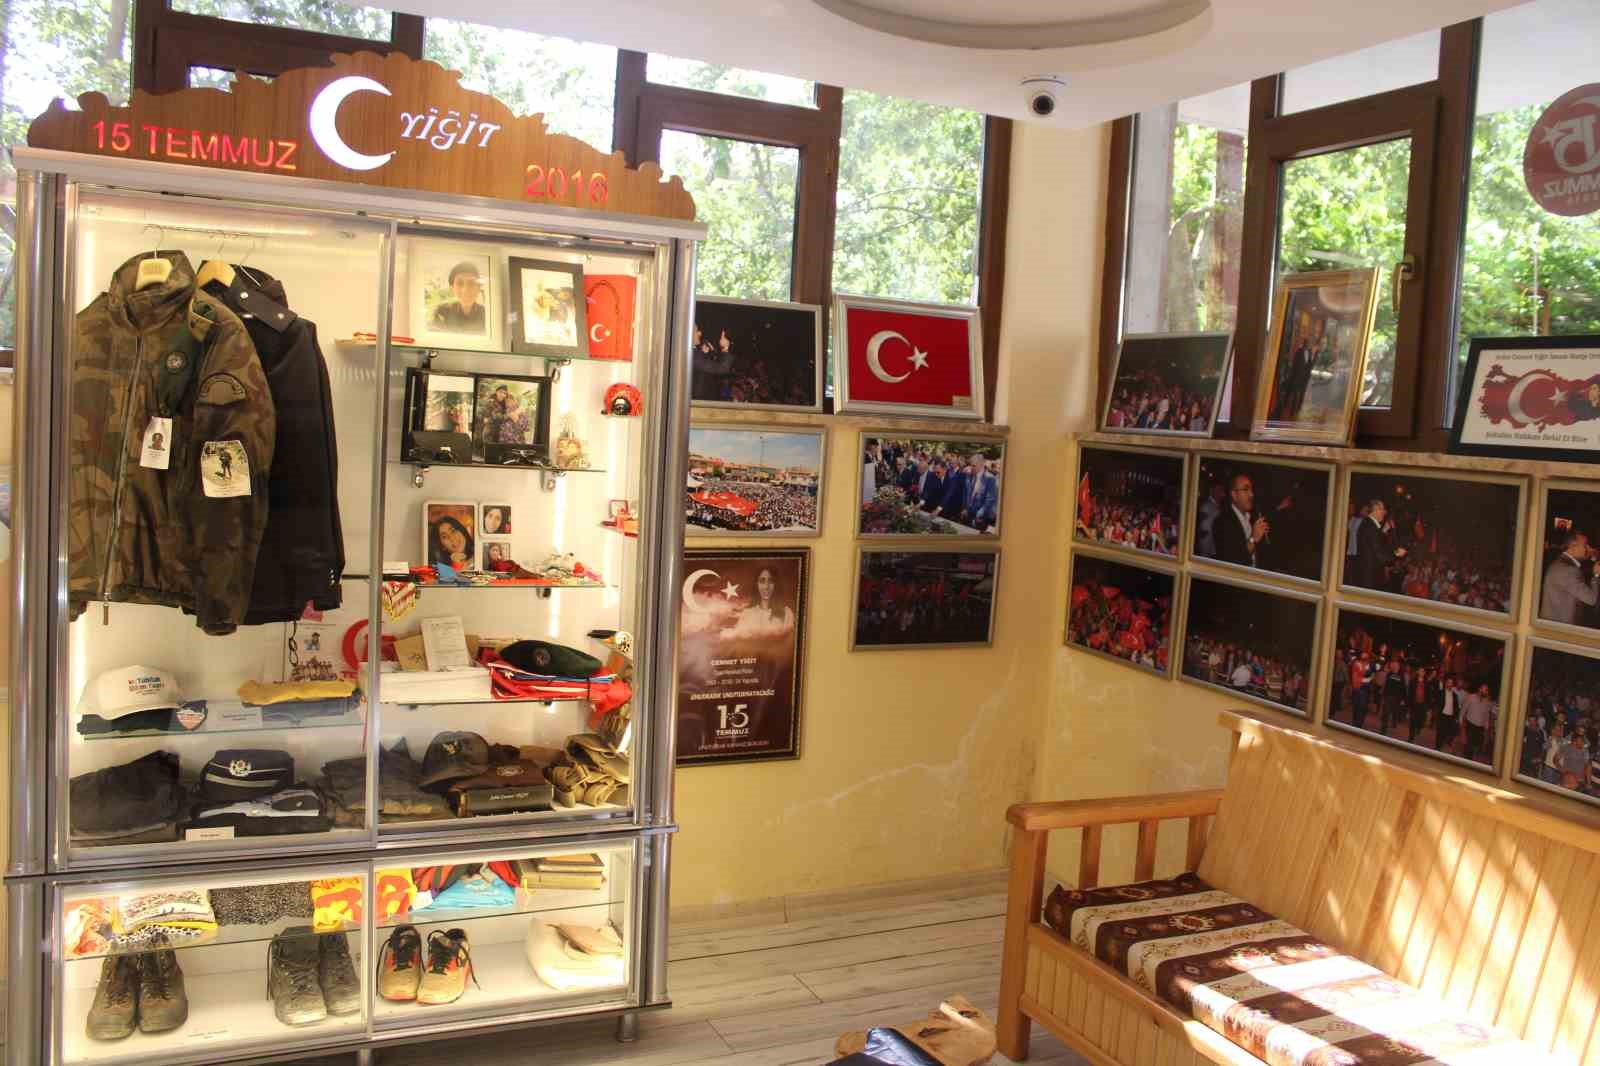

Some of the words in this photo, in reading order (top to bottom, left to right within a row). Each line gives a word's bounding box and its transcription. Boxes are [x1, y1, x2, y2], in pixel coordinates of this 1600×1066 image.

[92, 120, 131, 152] 15
[142, 124, 298, 170] TEMMUZ
[526, 163, 609, 204] 2016
[716, 728, 750, 737] TEMMUZ
[717, 703, 749, 729] 15
